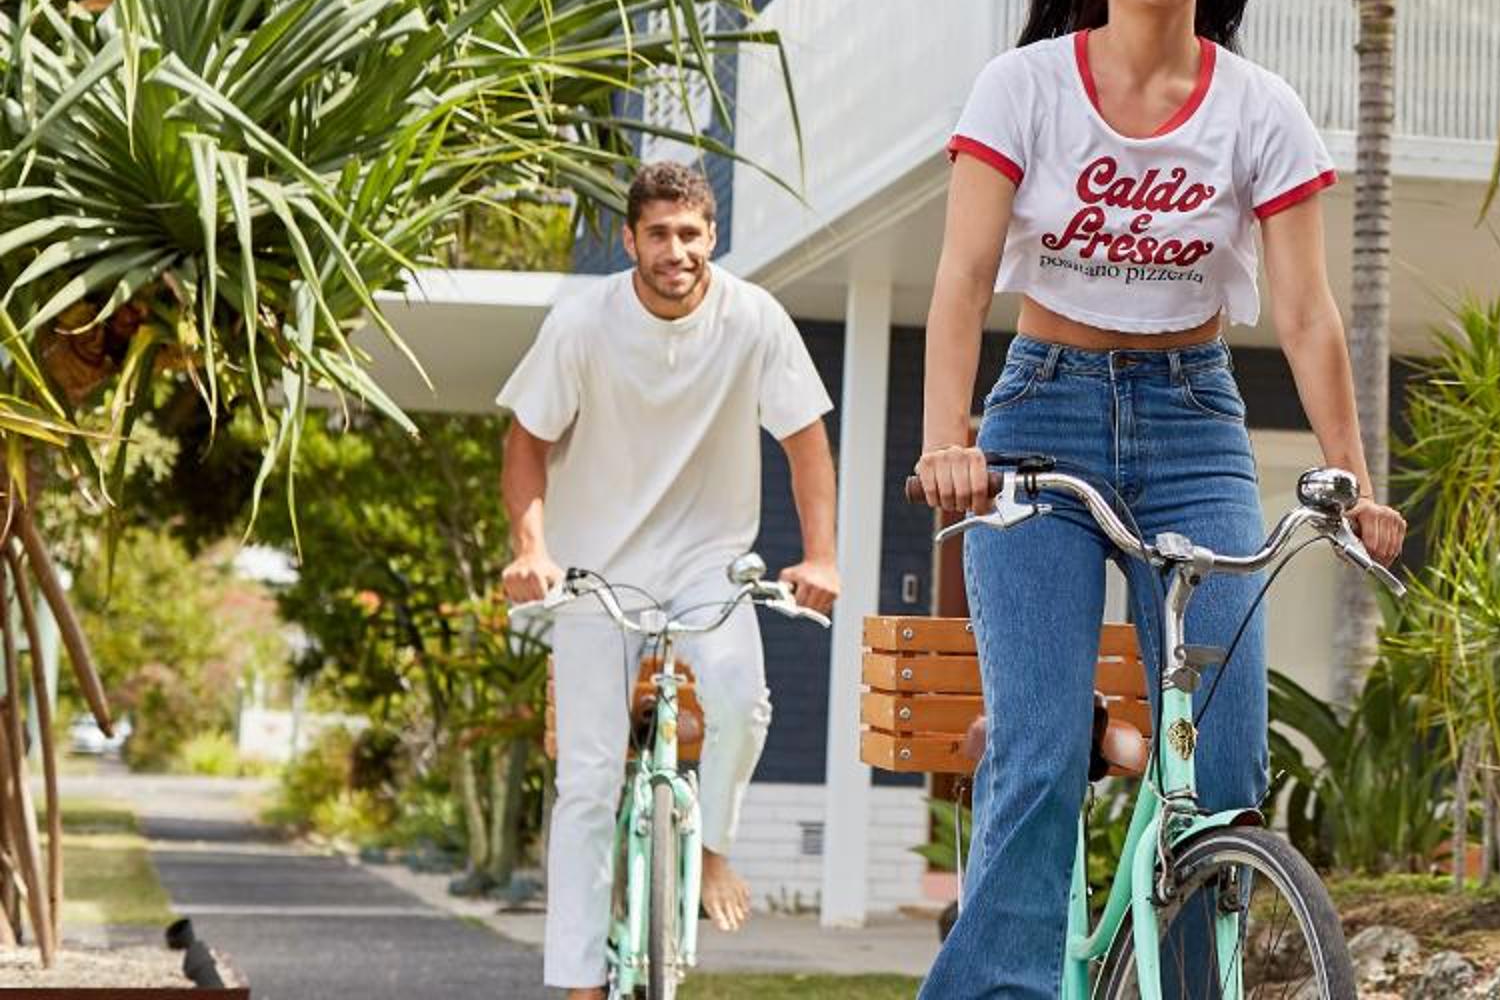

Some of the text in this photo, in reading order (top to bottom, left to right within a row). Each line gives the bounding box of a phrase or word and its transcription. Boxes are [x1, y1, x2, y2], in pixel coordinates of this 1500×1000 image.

[1076, 156, 1216, 213] Caldo
[1041, 205, 1215, 267] Fresco
[1130, 213, 1153, 234] e
